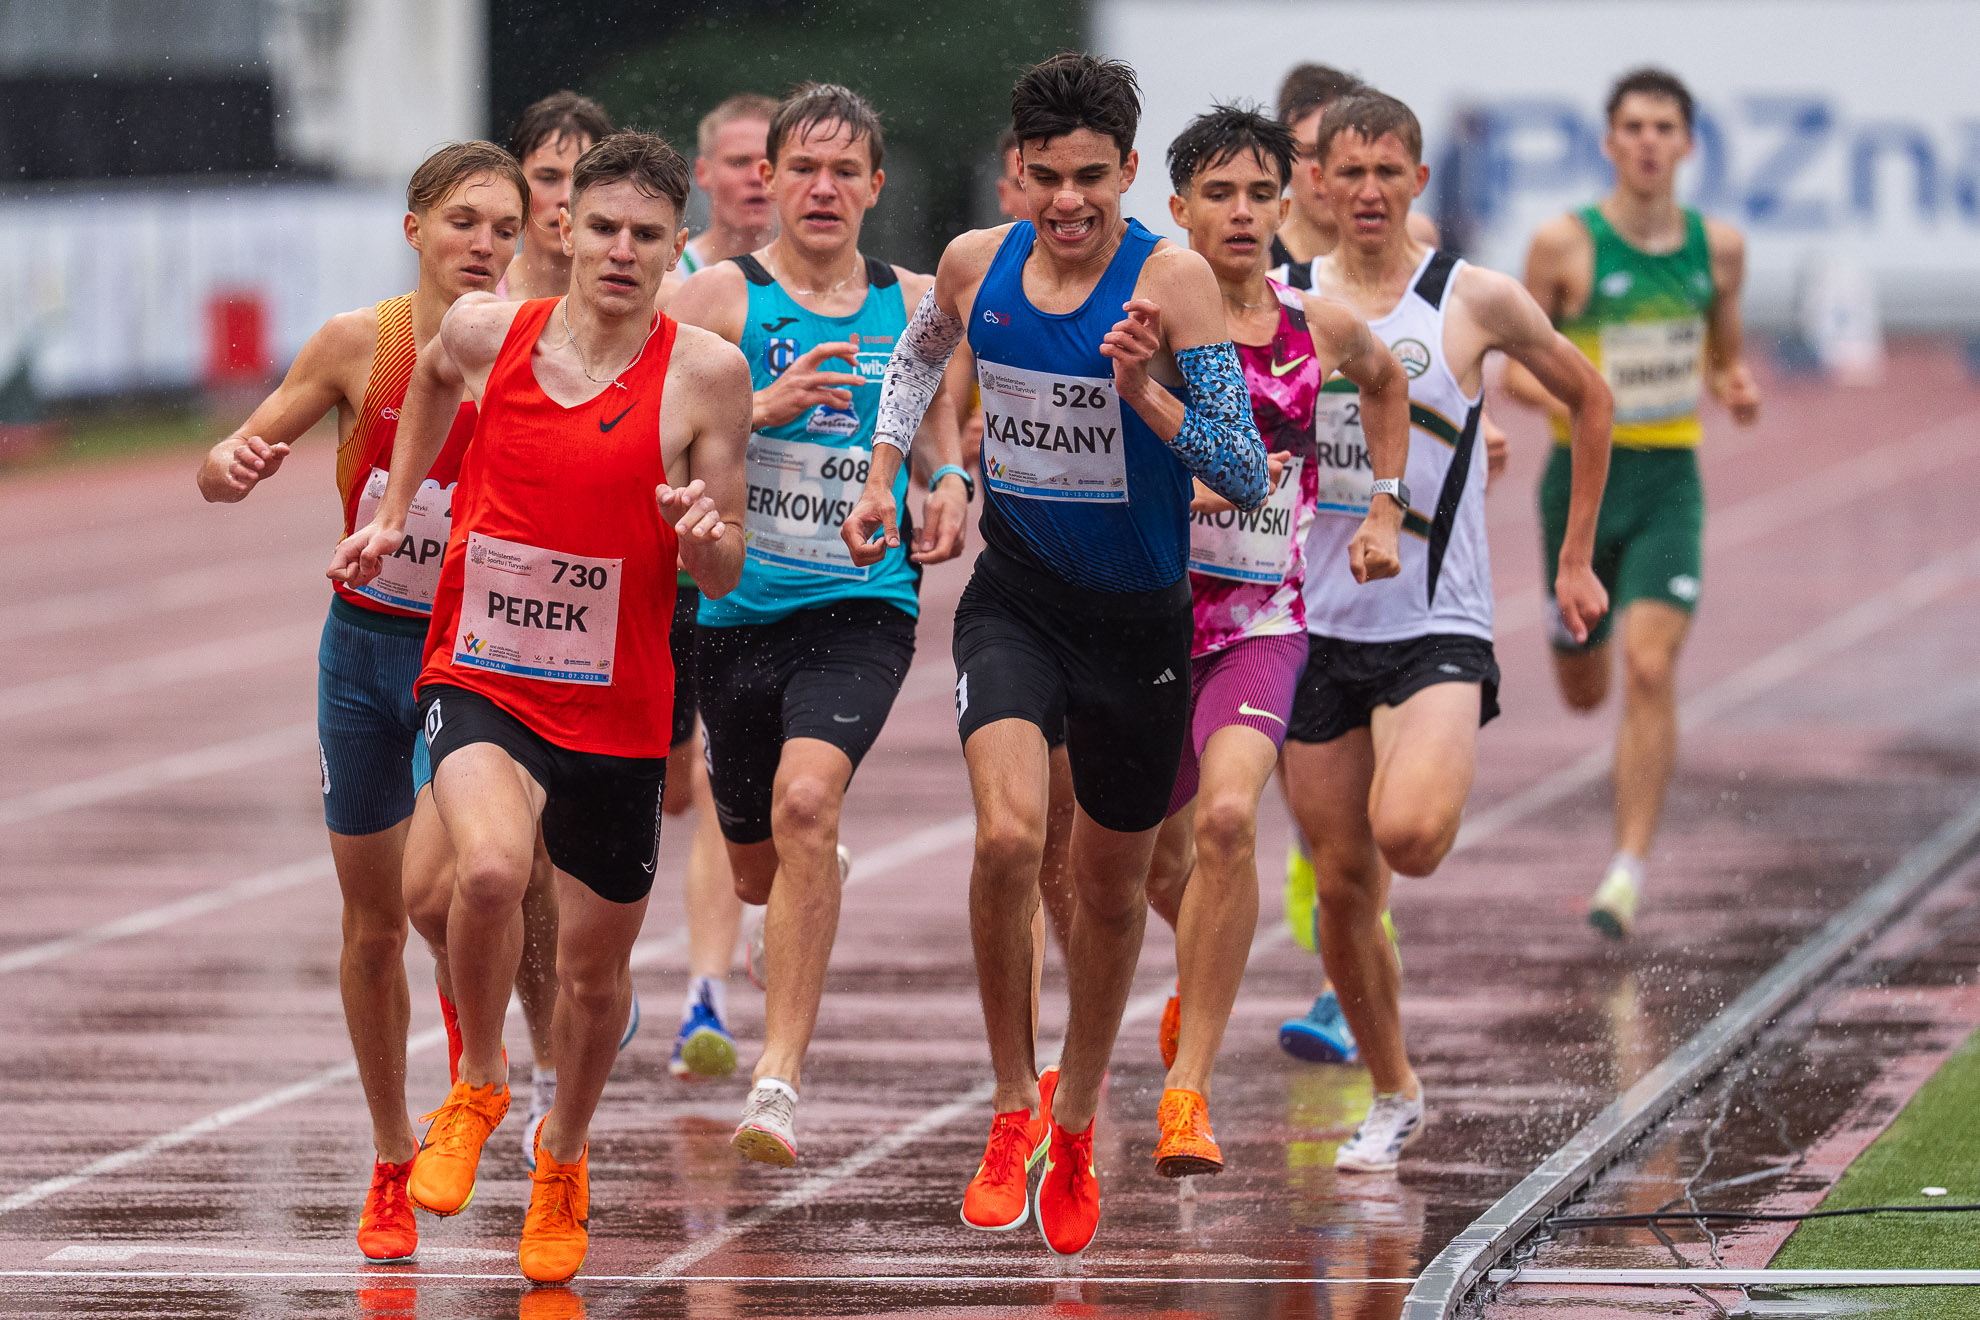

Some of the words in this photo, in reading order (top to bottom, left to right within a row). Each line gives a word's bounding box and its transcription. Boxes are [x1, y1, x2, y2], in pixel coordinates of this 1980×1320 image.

[860, 358, 889, 375] wib
[996, 375, 1025, 386] Ministerstwo
[996, 382, 1011, 390] Sportu
[1015, 386, 1036, 394] Turystyki
[1052, 382, 1106, 409] 526
[1344, 402, 1360, 426] 2
[985, 411, 1116, 454] KASZANY
[1317, 441, 1373, 471] RUK
[821, 456, 869, 483] 608
[1281, 465, 1293, 489] 7
[746, 483, 854, 528] ERKOWS
[388, 534, 449, 569] AP
[488, 549, 521, 562] Ministerstwo
[487, 557, 504, 566] Sportu
[508, 561, 532, 571] Turystyki
[551, 559, 608, 590] 730
[487, 590, 589, 633] PEREK
[475, 659, 507, 670] POZNAŃ
[544, 670, 599, 680] 10-13.07.2025
